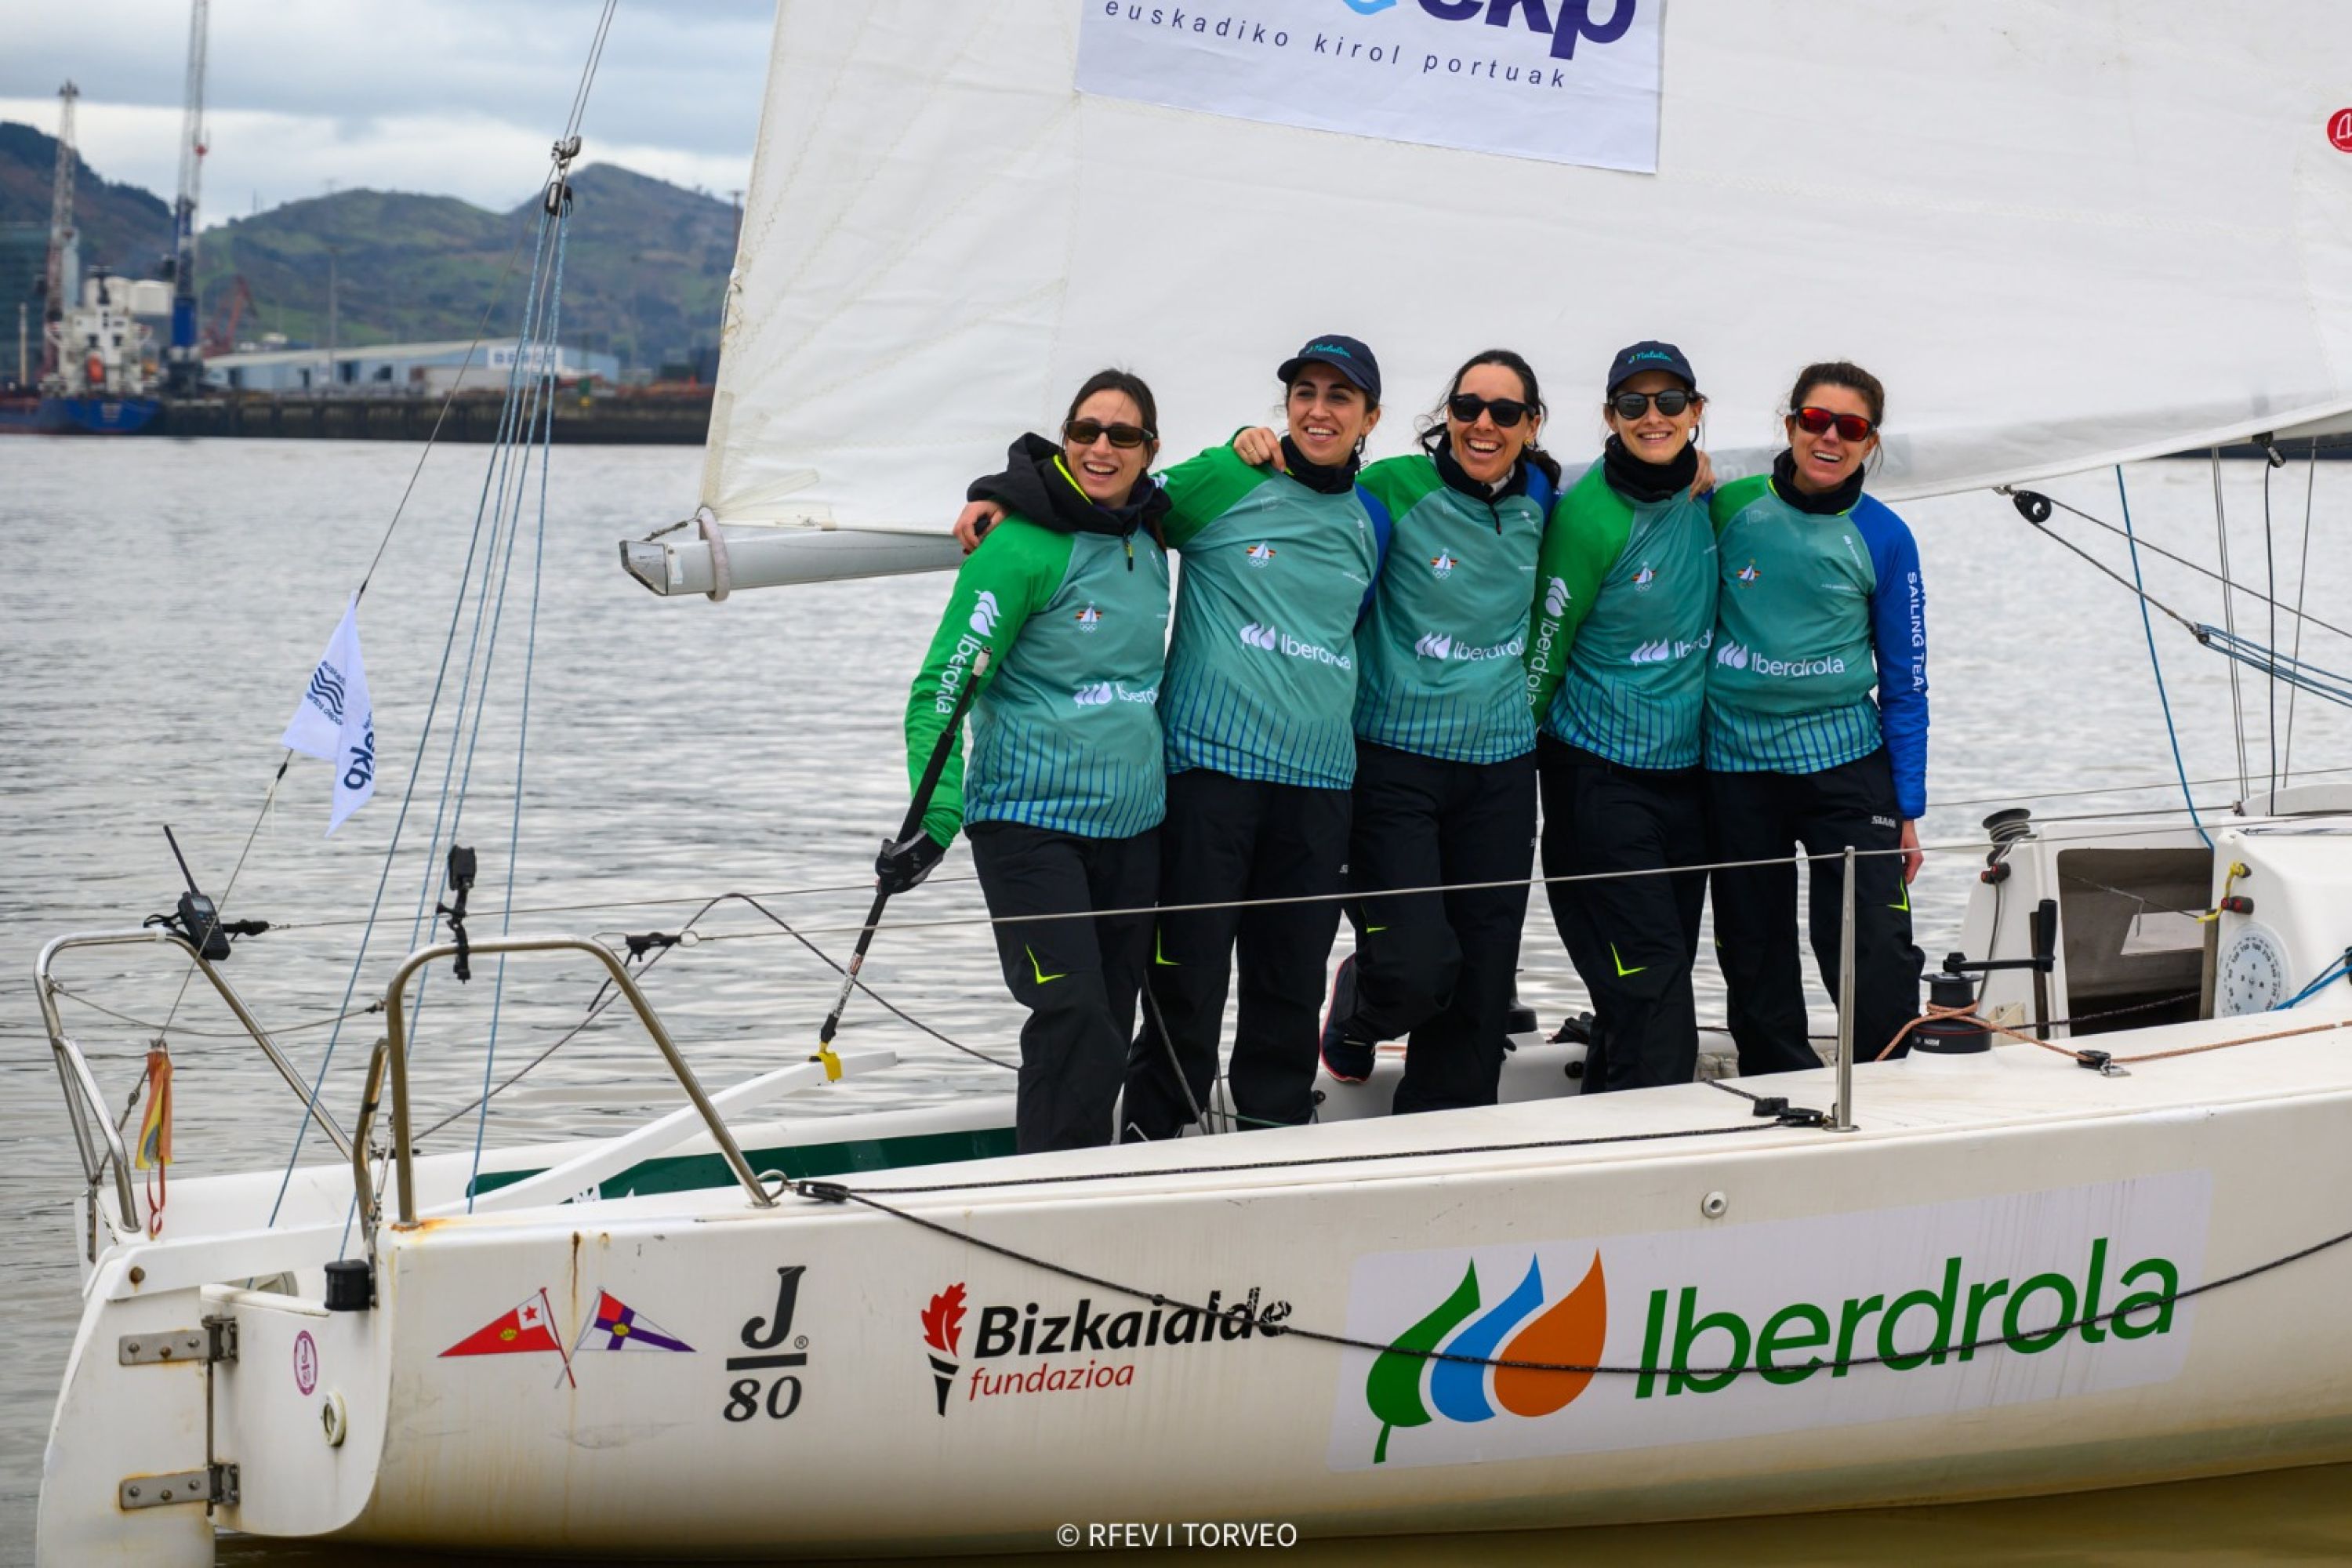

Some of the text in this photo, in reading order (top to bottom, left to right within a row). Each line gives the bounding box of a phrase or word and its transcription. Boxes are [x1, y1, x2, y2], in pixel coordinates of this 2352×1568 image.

[1105, 1, 1566, 89] euskadiko kirol portuak
[1907, 572, 1925, 648] SAILING
[1453, 636, 1525, 661] Iberdrol
[1751, 652, 1846, 677] Iberdrola
[975, 1287, 1293, 1359] Bizkaialde
[1635, 1238, 2179, 1399] Iberdrola
[723, 1376, 802, 1422] 80
[969, 1360, 1135, 1402] fundazioa
